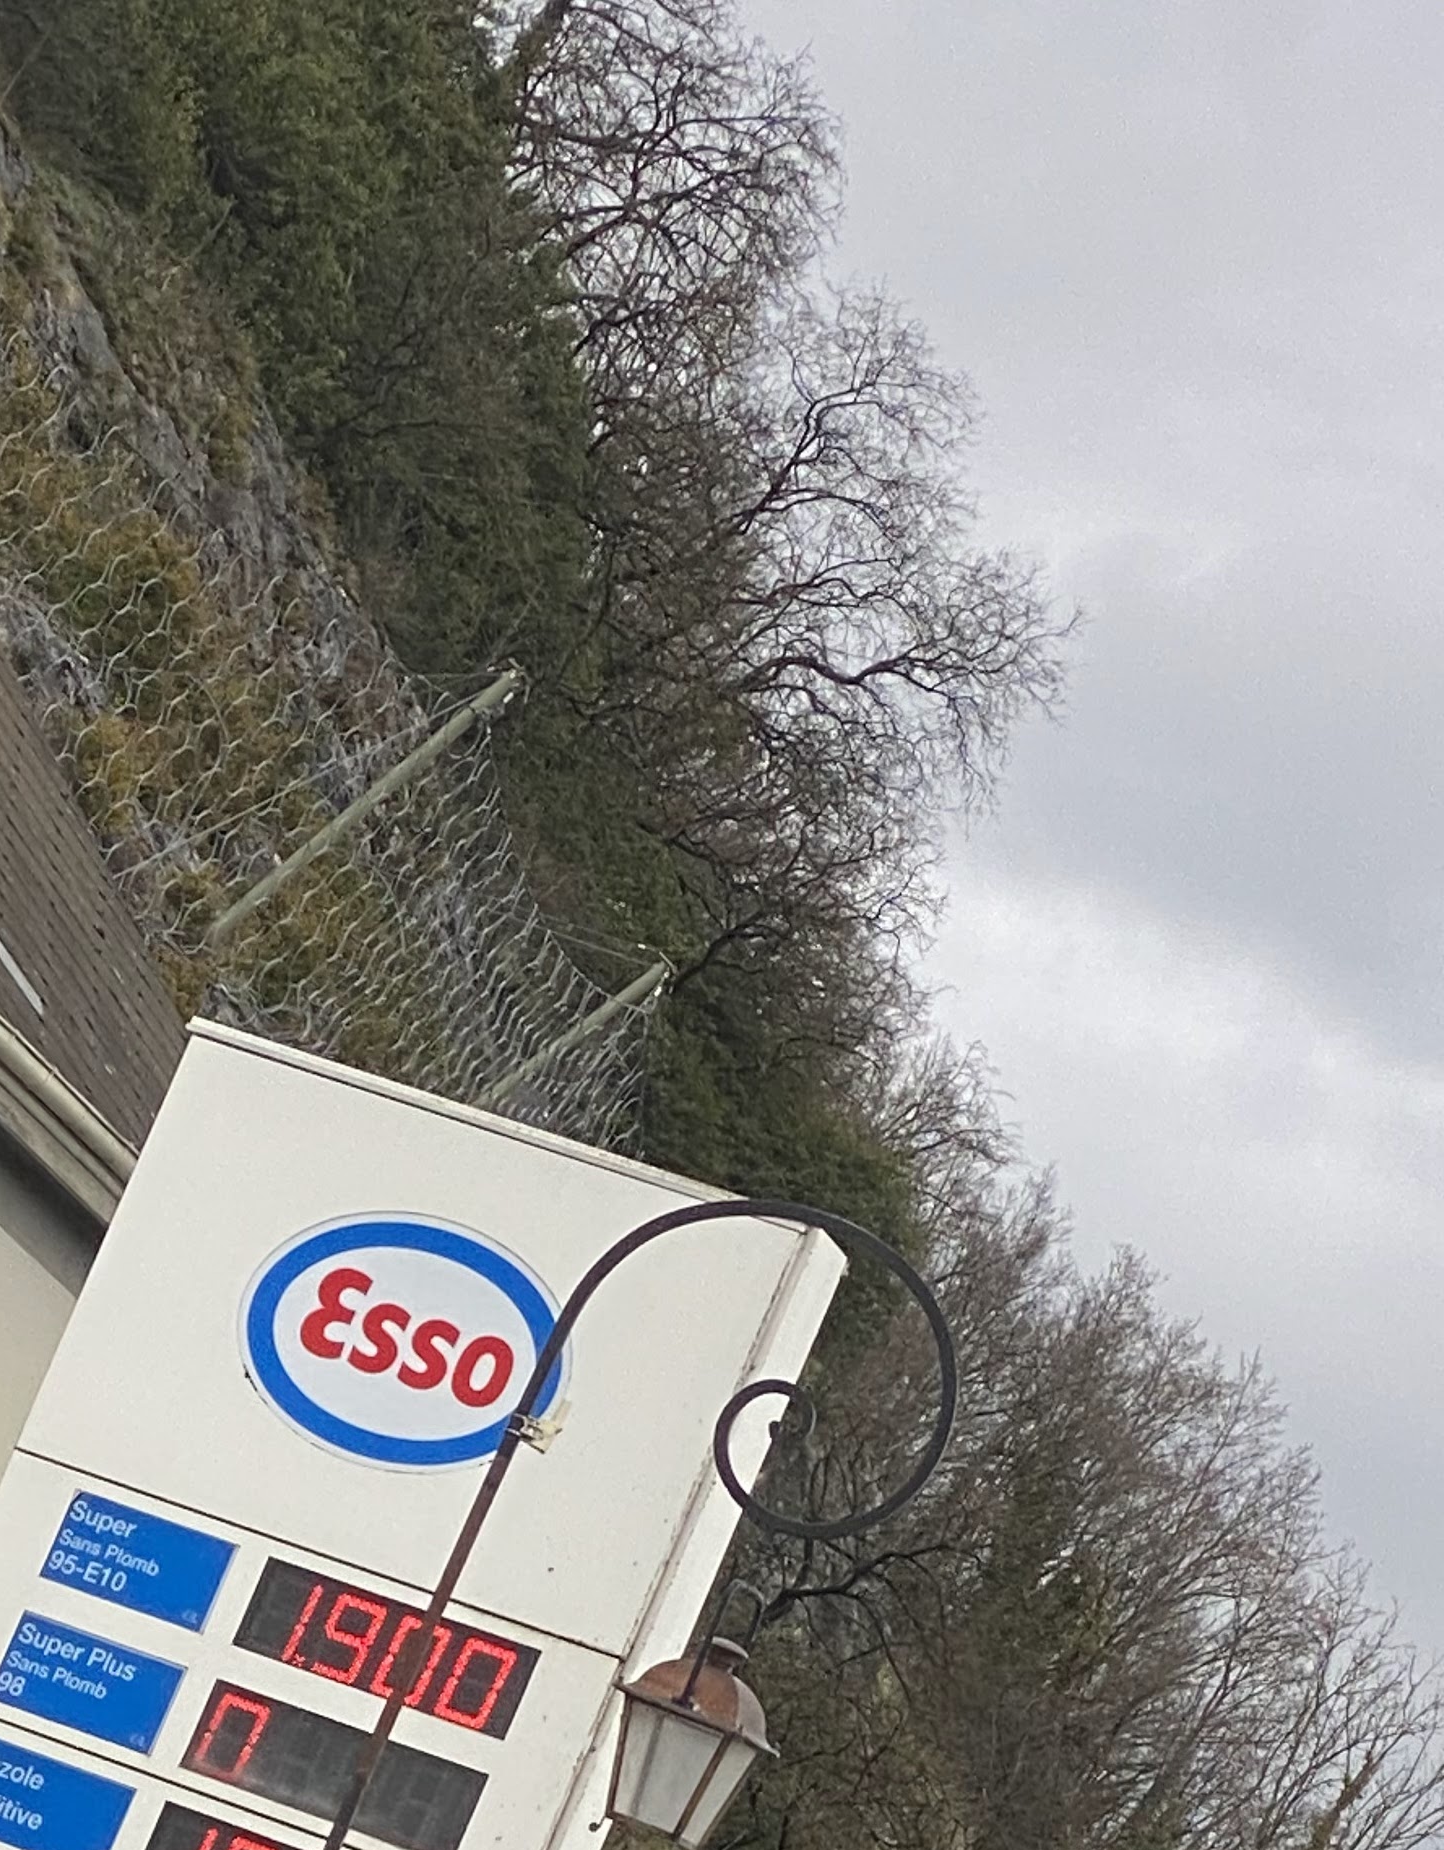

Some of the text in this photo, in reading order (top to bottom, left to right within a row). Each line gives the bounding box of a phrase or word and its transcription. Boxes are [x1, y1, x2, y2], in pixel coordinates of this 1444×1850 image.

[69, 1500, 138, 1538] Super
[47, 1549, 128, 1592] 95-E10
[59, 1528, 160, 1577] Sans Plomb
[6, 1650, 107, 1700] Sans Plomb
[17, 1622, 137, 1682] Super Plus
